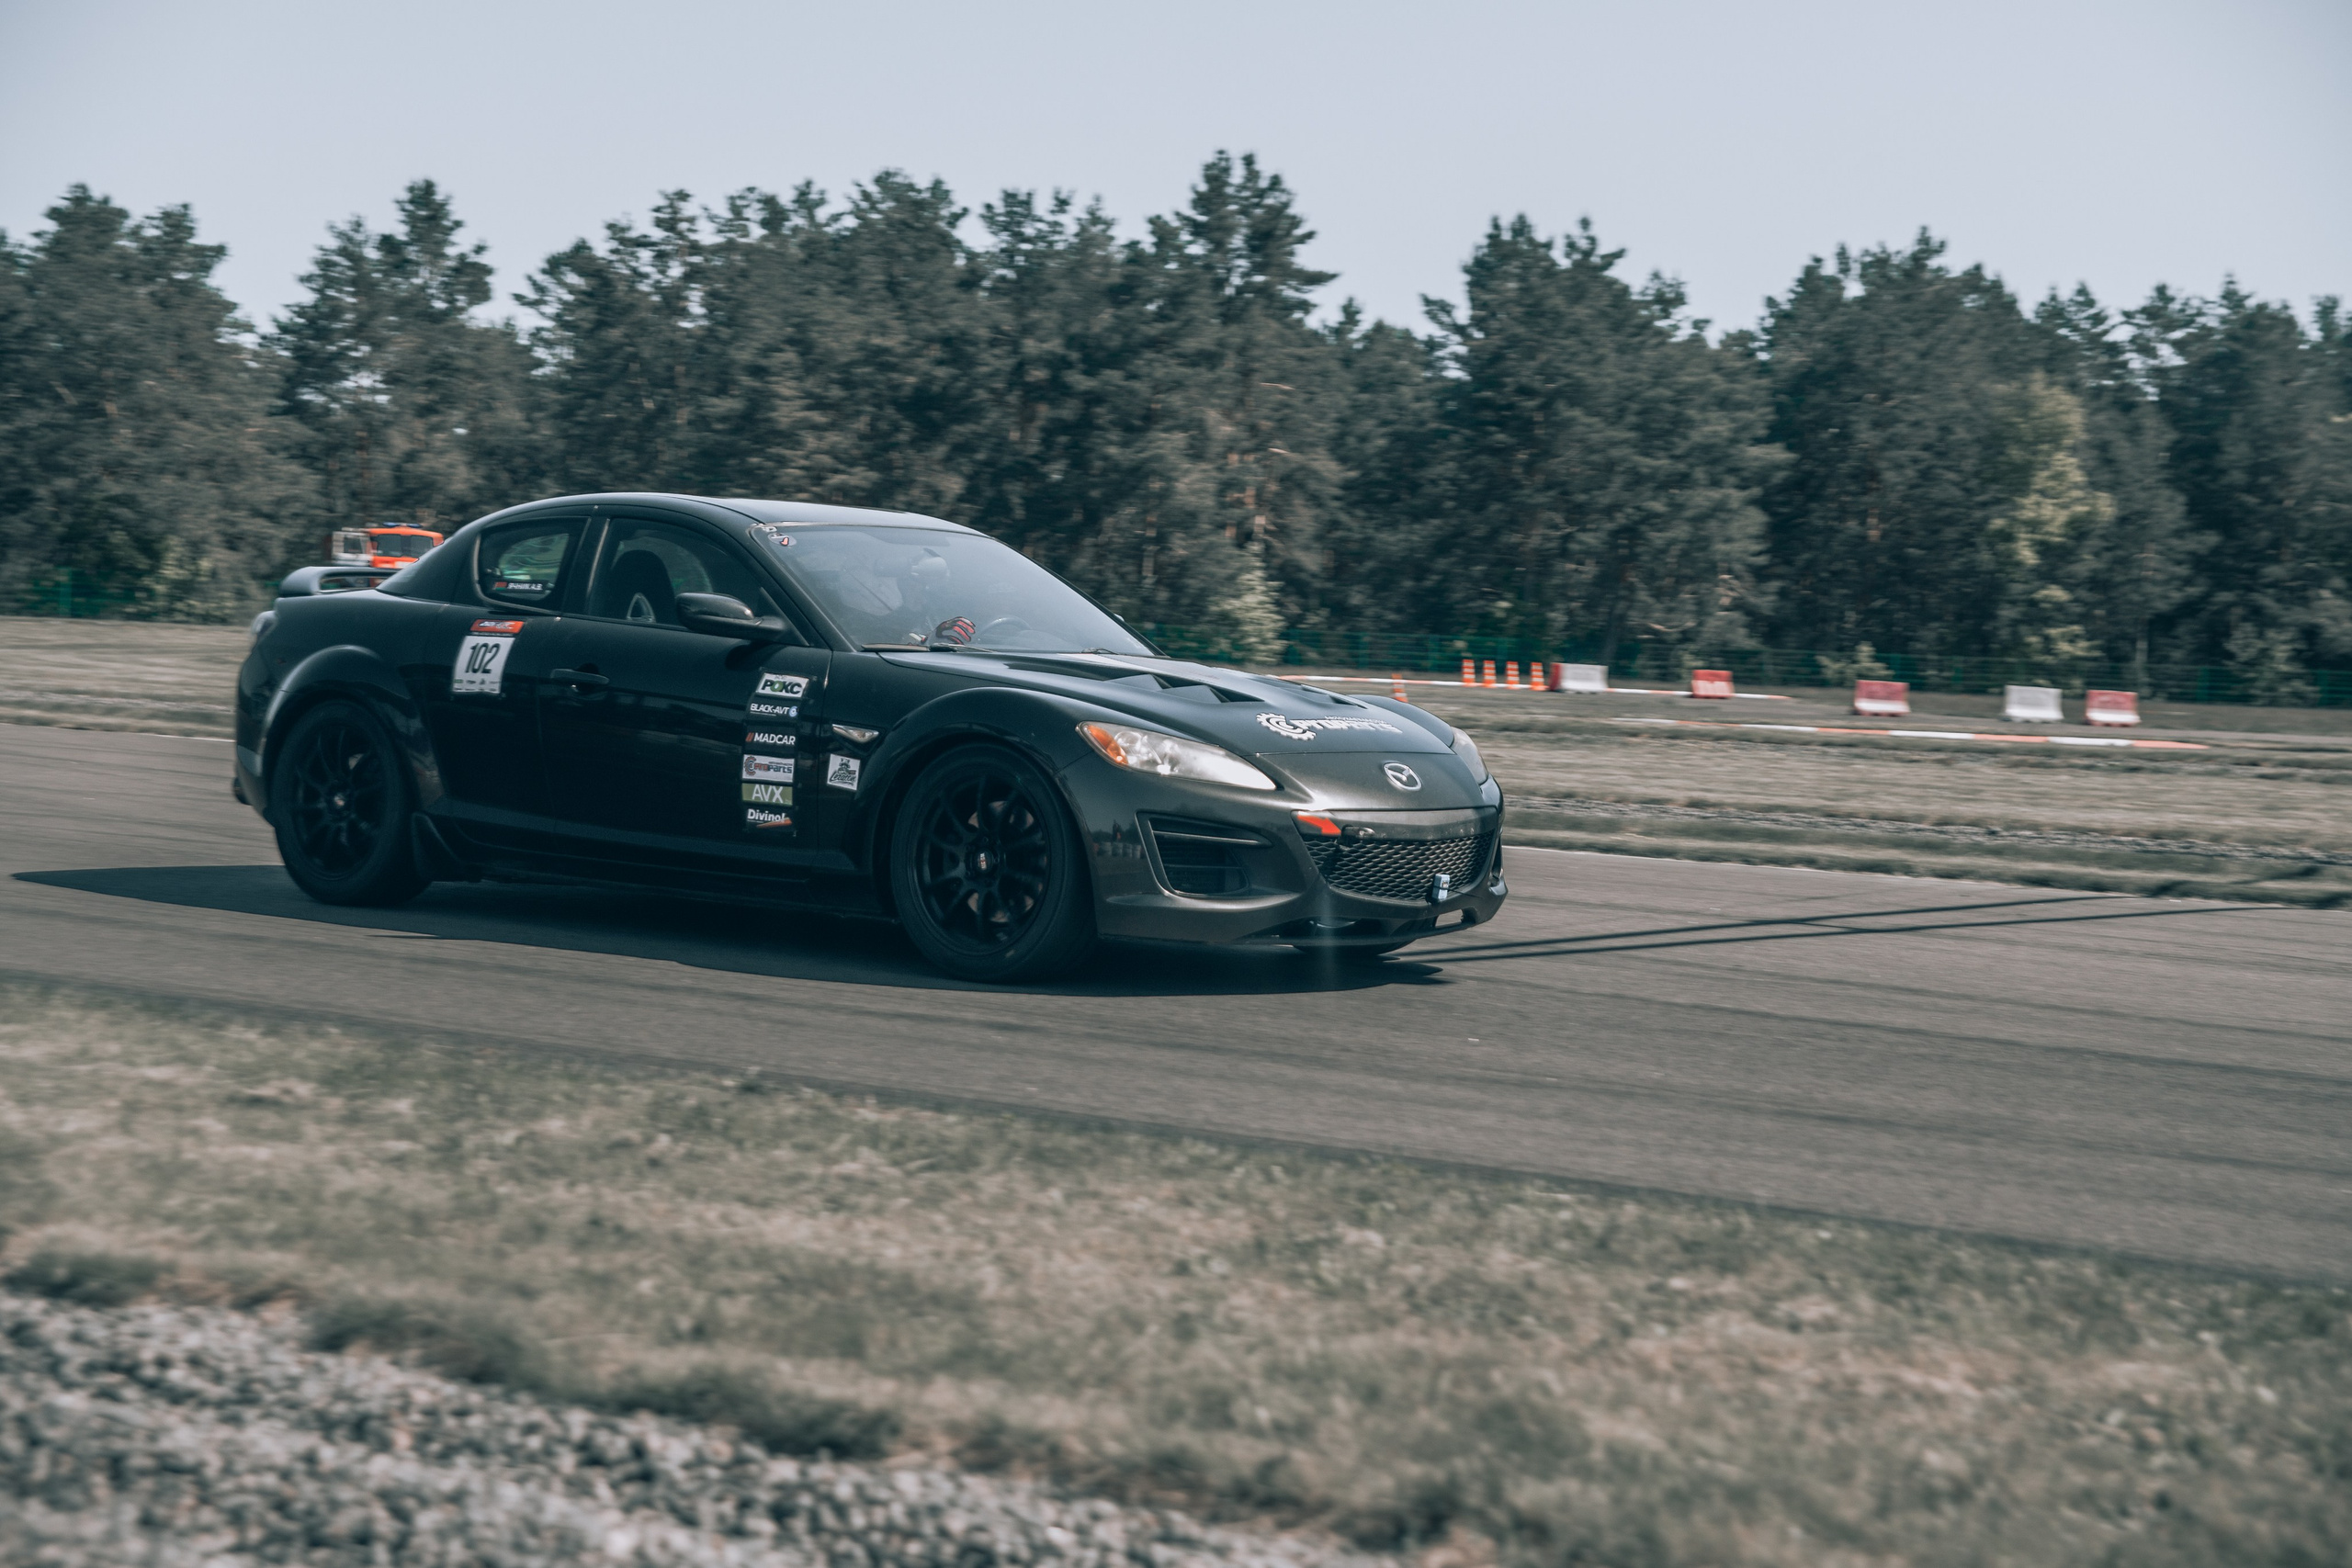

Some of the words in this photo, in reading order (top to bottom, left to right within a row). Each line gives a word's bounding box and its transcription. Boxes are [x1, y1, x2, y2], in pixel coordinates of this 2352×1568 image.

[465, 642, 500, 673] 102
[753, 732, 796, 745] MADCAR
[752, 784, 784, 804] AVX
